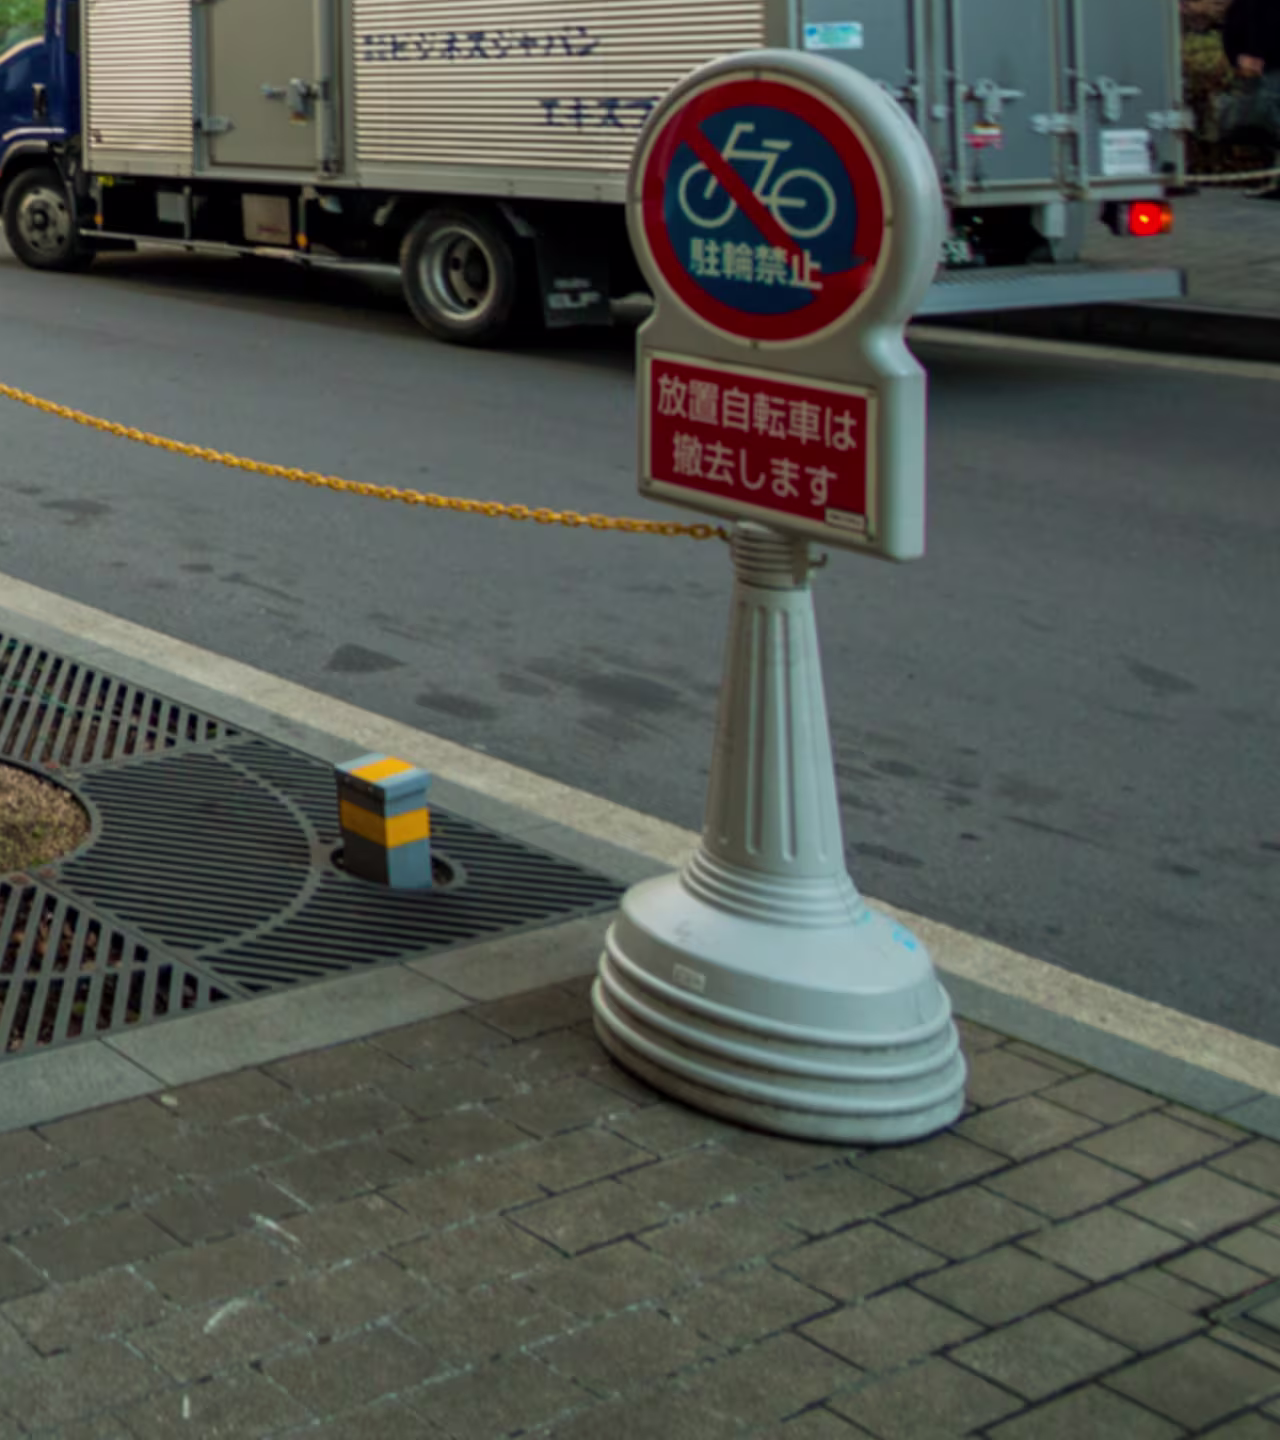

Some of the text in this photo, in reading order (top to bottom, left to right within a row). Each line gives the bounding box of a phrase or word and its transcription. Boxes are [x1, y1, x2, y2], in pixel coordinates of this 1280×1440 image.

[689, 237, 824, 290] 駐輪禁止
[656, 372, 858, 452] 放置自転車は
[671, 430, 838, 507] 撤去します
